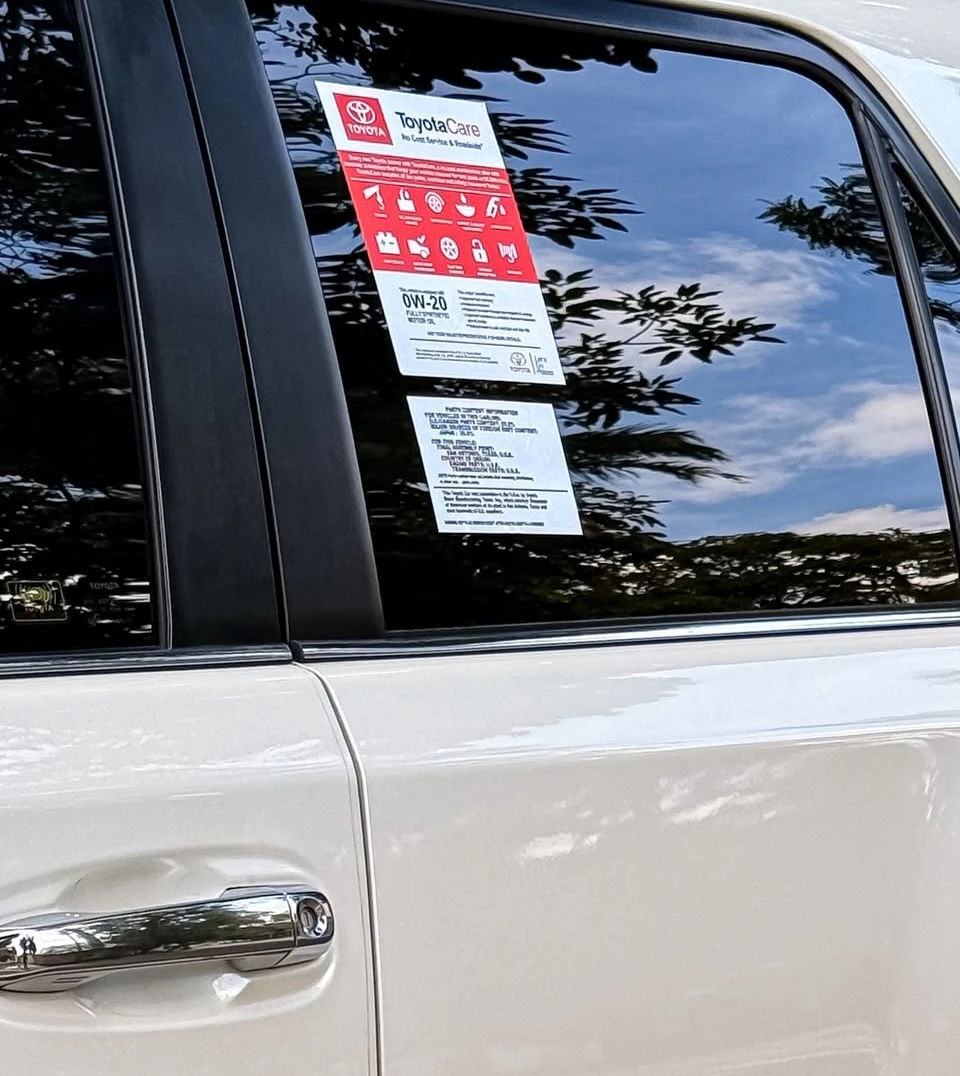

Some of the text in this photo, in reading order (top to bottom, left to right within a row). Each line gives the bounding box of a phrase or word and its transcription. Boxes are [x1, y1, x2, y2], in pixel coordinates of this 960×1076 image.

[347, 123, 386, 138] TOYOTA
[394, 111, 481, 138] ToyotaCare
[402, 293, 447, 311] 0W-20
